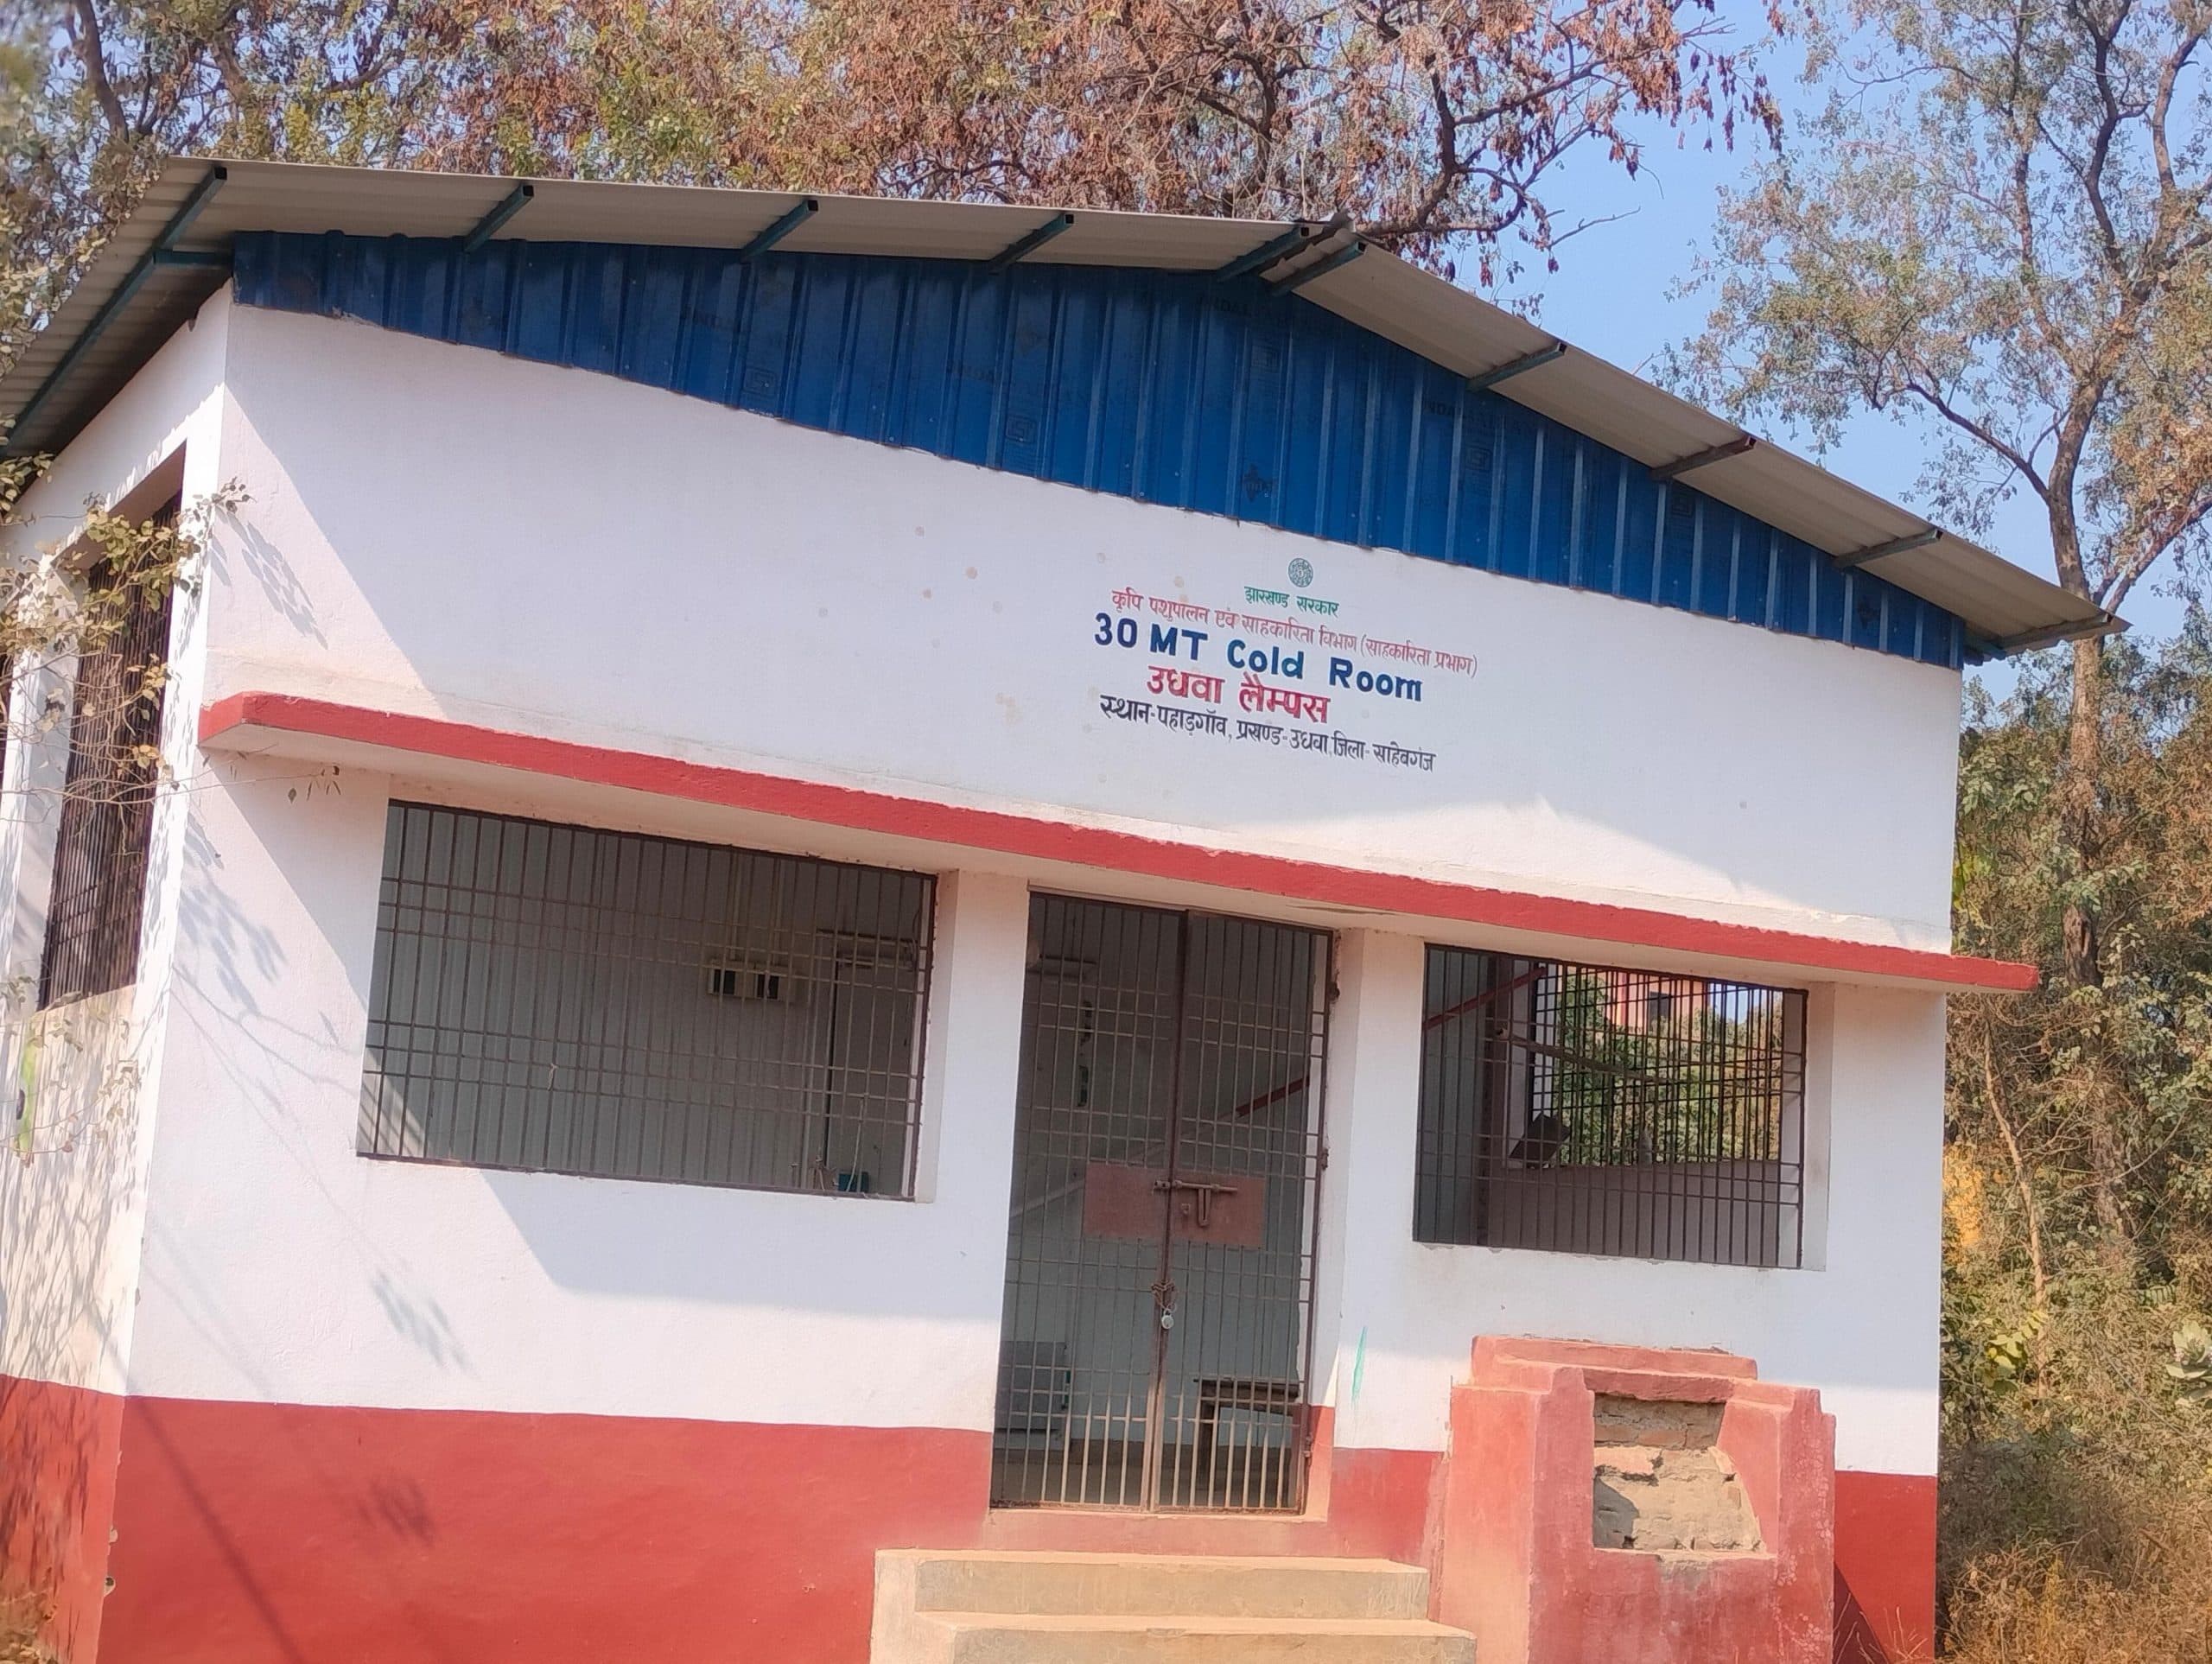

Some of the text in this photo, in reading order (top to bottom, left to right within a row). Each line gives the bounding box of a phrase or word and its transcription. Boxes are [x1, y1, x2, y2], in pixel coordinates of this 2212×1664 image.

[1296, 595, 1339, 619] सरकार
[1095, 613, 1423, 702] 30 MT Cold Room
[1149, 597, 1210, 624] पशुपालन
[1319, 625, 1357, 651] विभाग
[1434, 651, 1478, 679] प्रभाग)
[1147, 666, 1225, 703] उधवा
